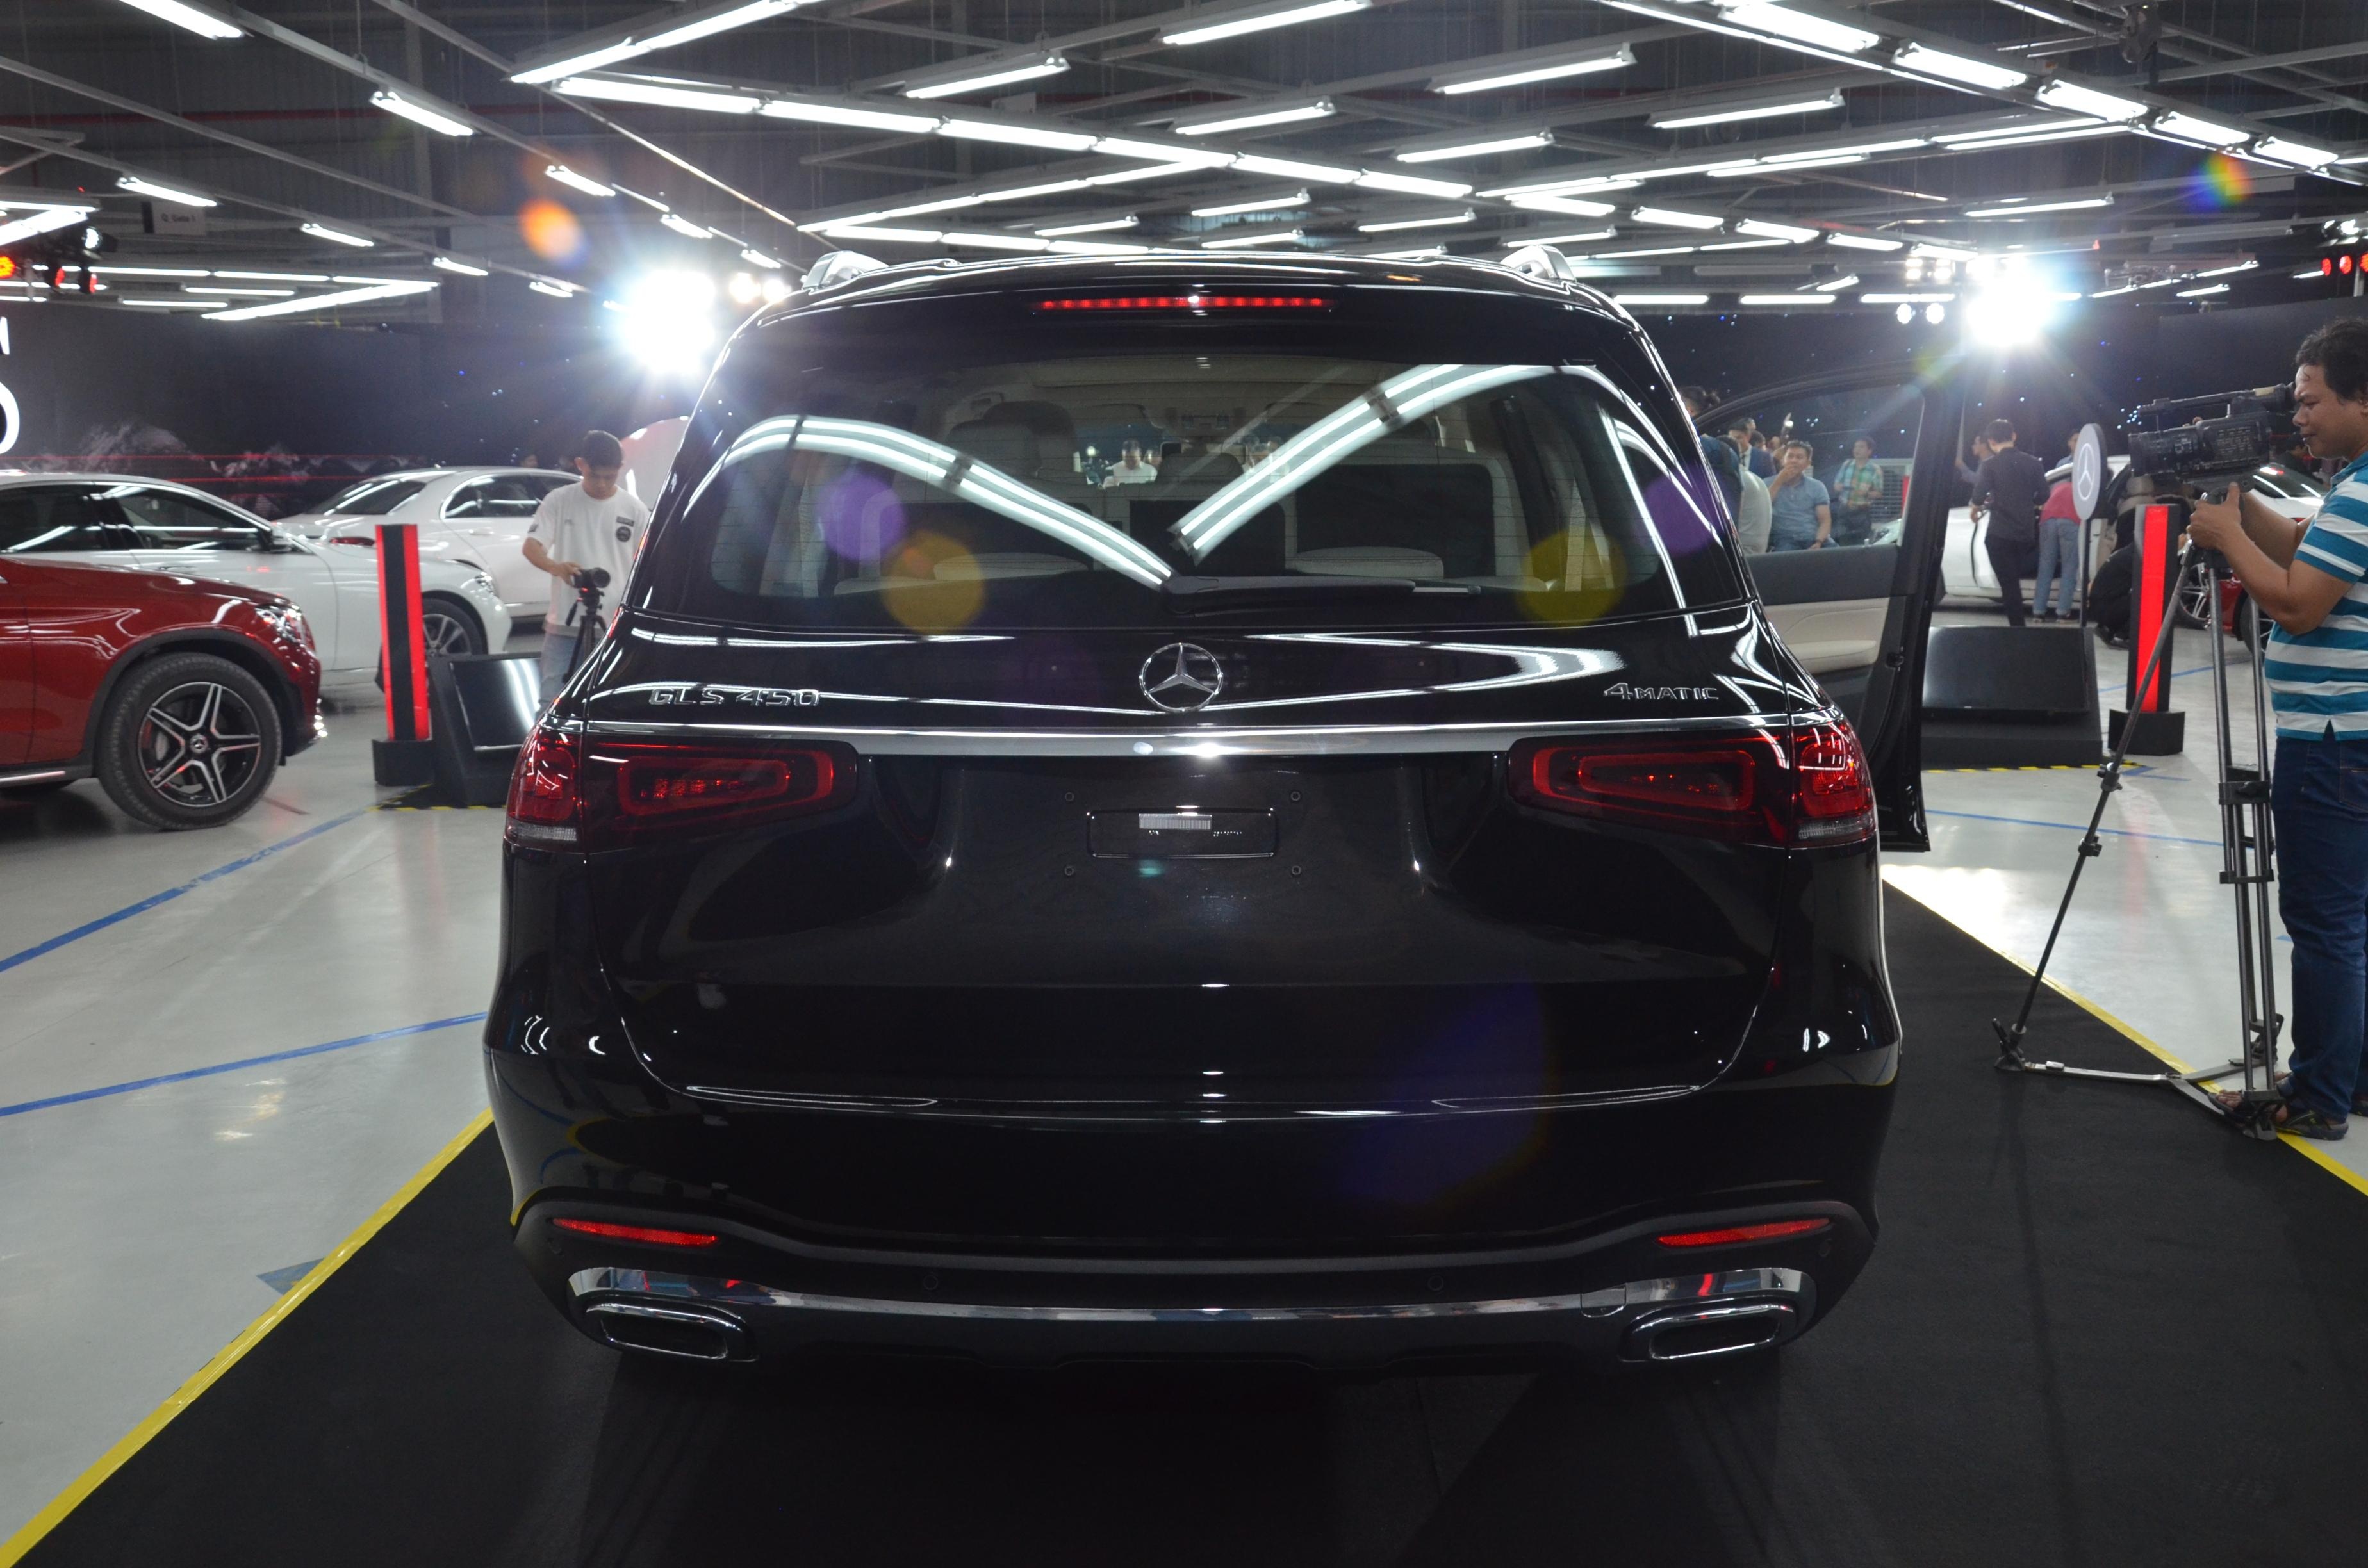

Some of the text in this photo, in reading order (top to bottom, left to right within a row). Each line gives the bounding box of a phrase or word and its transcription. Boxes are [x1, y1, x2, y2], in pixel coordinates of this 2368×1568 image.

[648, 688, 821, 706] GLS 450
[1604, 682, 1719, 700] 4MATIC
